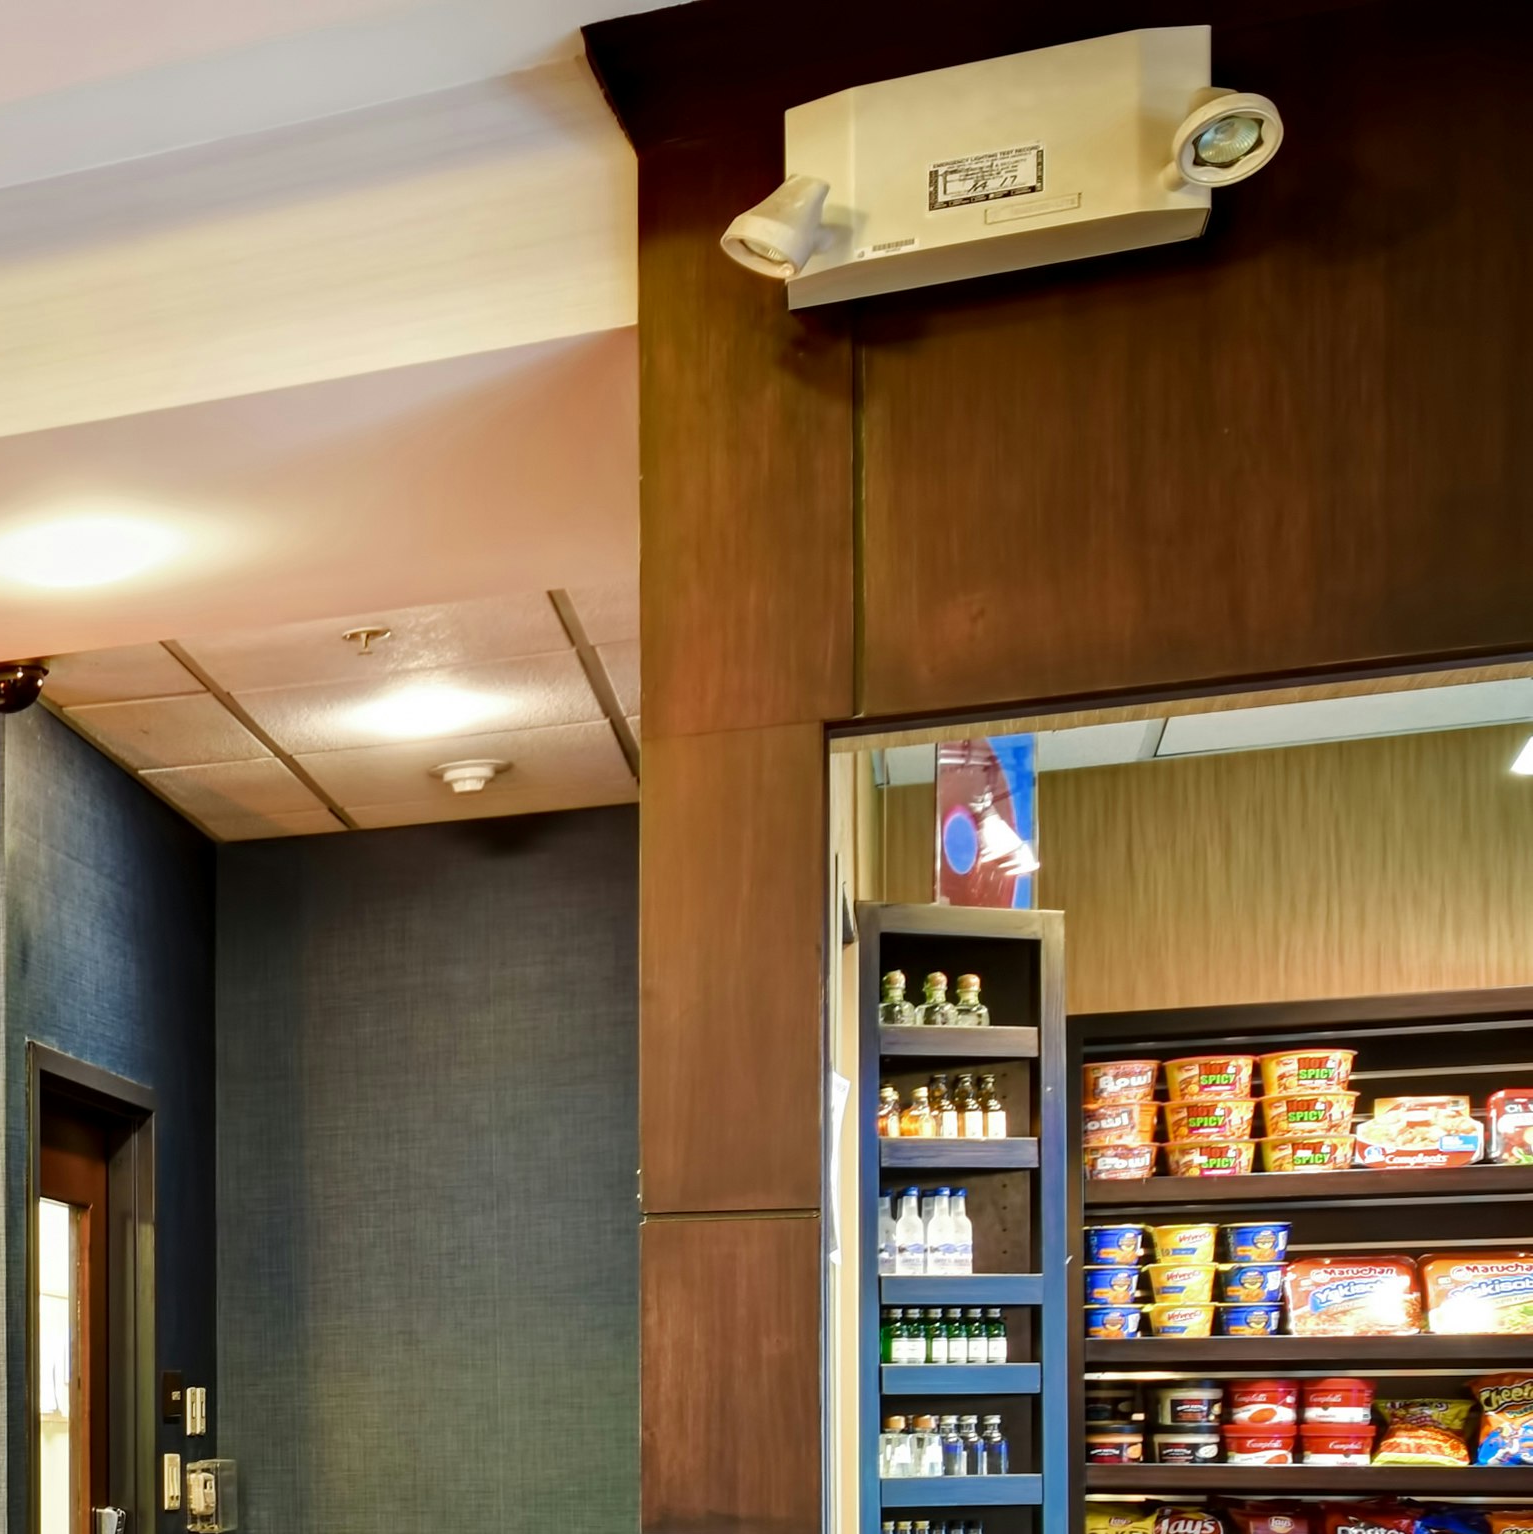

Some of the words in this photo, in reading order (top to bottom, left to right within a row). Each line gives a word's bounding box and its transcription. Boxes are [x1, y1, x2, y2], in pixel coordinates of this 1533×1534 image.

[1299, 1068, 1335, 1079] SPICY
[1200, 1074, 1235, 1085] SPICY
[1086, 1112, 1129, 1131] owl
[1188, 1116, 1225, 1127] SPICY
[1288, 1111, 1325, 1122] SPICY
[1202, 1157, 1235, 1168] SPICY
[1294, 1153, 1330, 1165] SPICY
[1323, 1267, 1394, 1276] Maruchan
